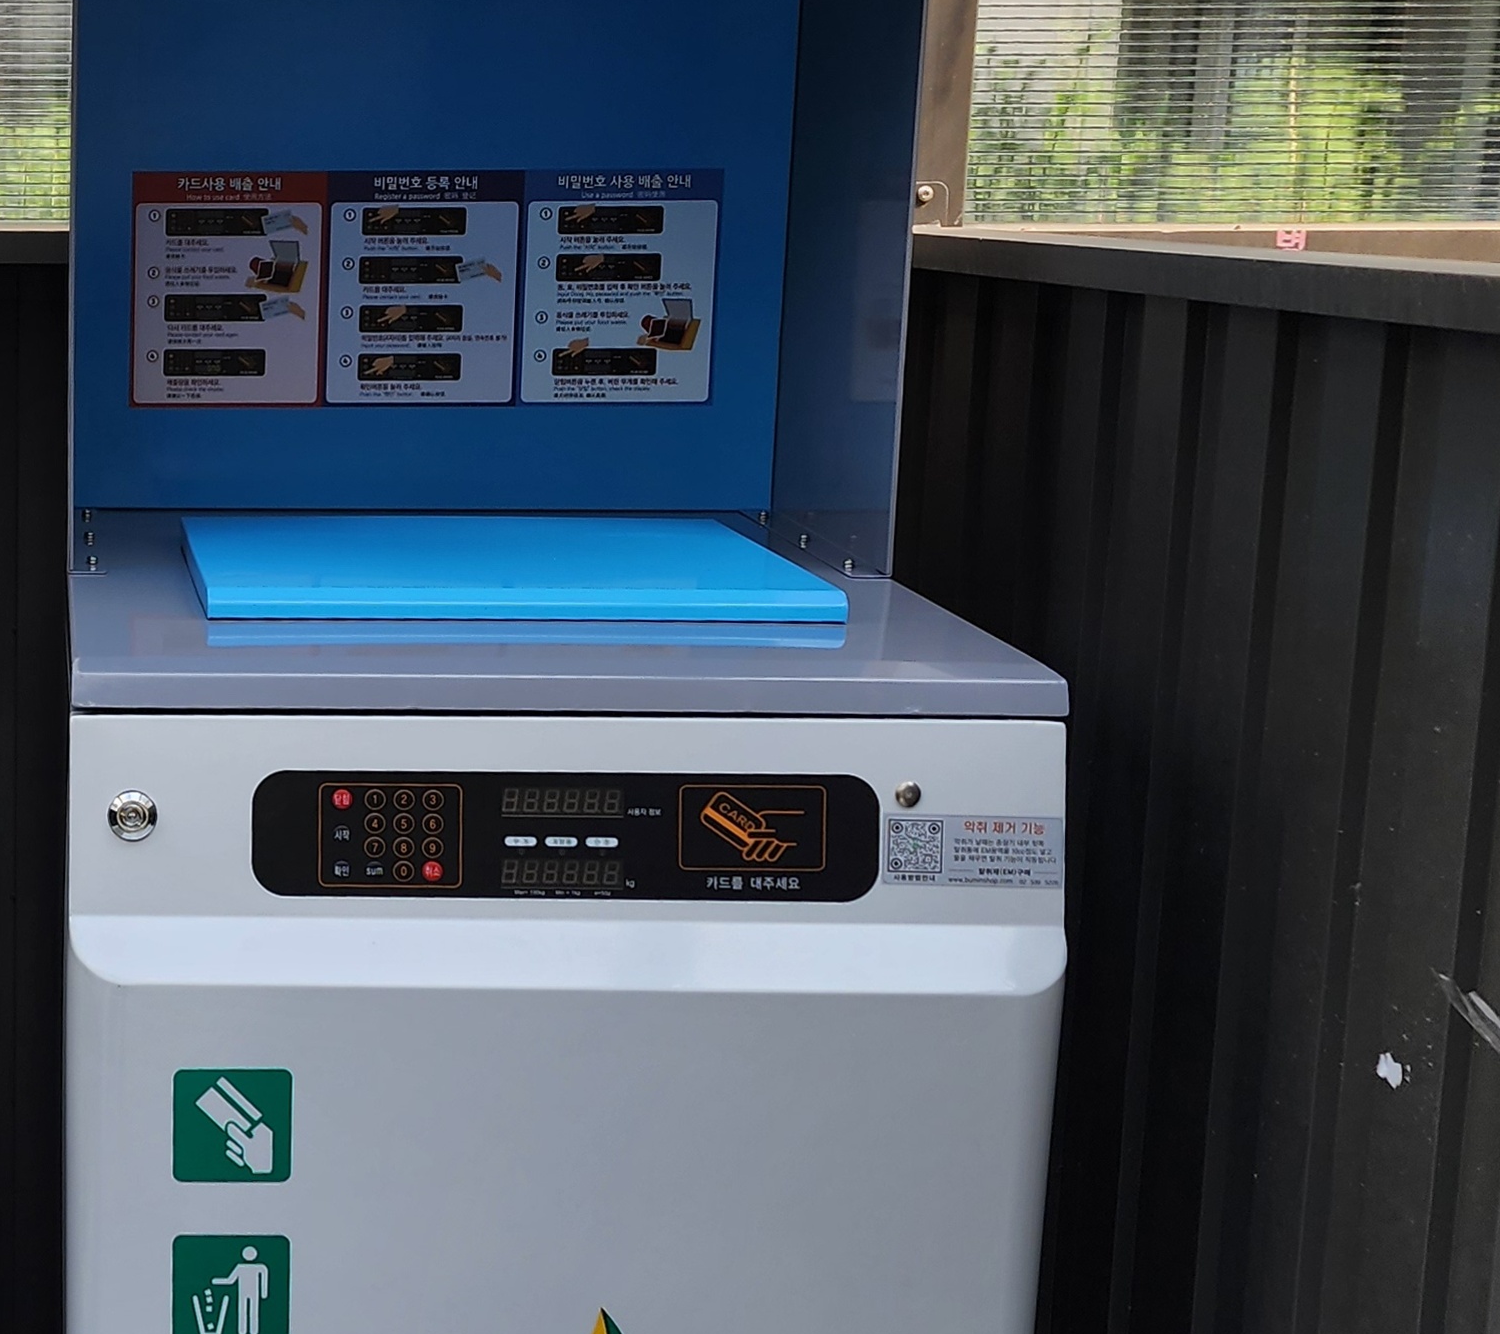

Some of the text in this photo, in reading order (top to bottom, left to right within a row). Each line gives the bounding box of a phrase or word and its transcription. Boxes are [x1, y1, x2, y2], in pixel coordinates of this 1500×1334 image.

[177, 177, 282, 192] 카드사용 배출 안내
[373, 176, 478, 191] 비밀번호 등록 안내
[558, 174, 692, 190] 비밀번호 사용 배출 안내
[374, 192, 402, 202] Register
[408, 192, 440, 202] password
[601, 191, 634, 200] password
[400, 794, 408, 805] 2
[429, 794, 437, 805] 3
[718, 802, 754, 831] CARD
[371, 818, 379, 829] 4
[401, 818, 408, 829] 5
[429, 818, 436, 829] 6
[964, 820, 1045, 835] 악취 제거 기능
[334, 830, 350, 841] 시작
[372, 843, 379, 854] 7
[400, 843, 408, 854] 8
[429, 843, 437, 854] 9
[334, 865, 350, 877] 확인
[366, 867, 384, 876] sum
[400, 865, 407, 876] 0
[626, 878, 636, 889] kg
[706, 876, 800, 891] 카드를 대주세요
